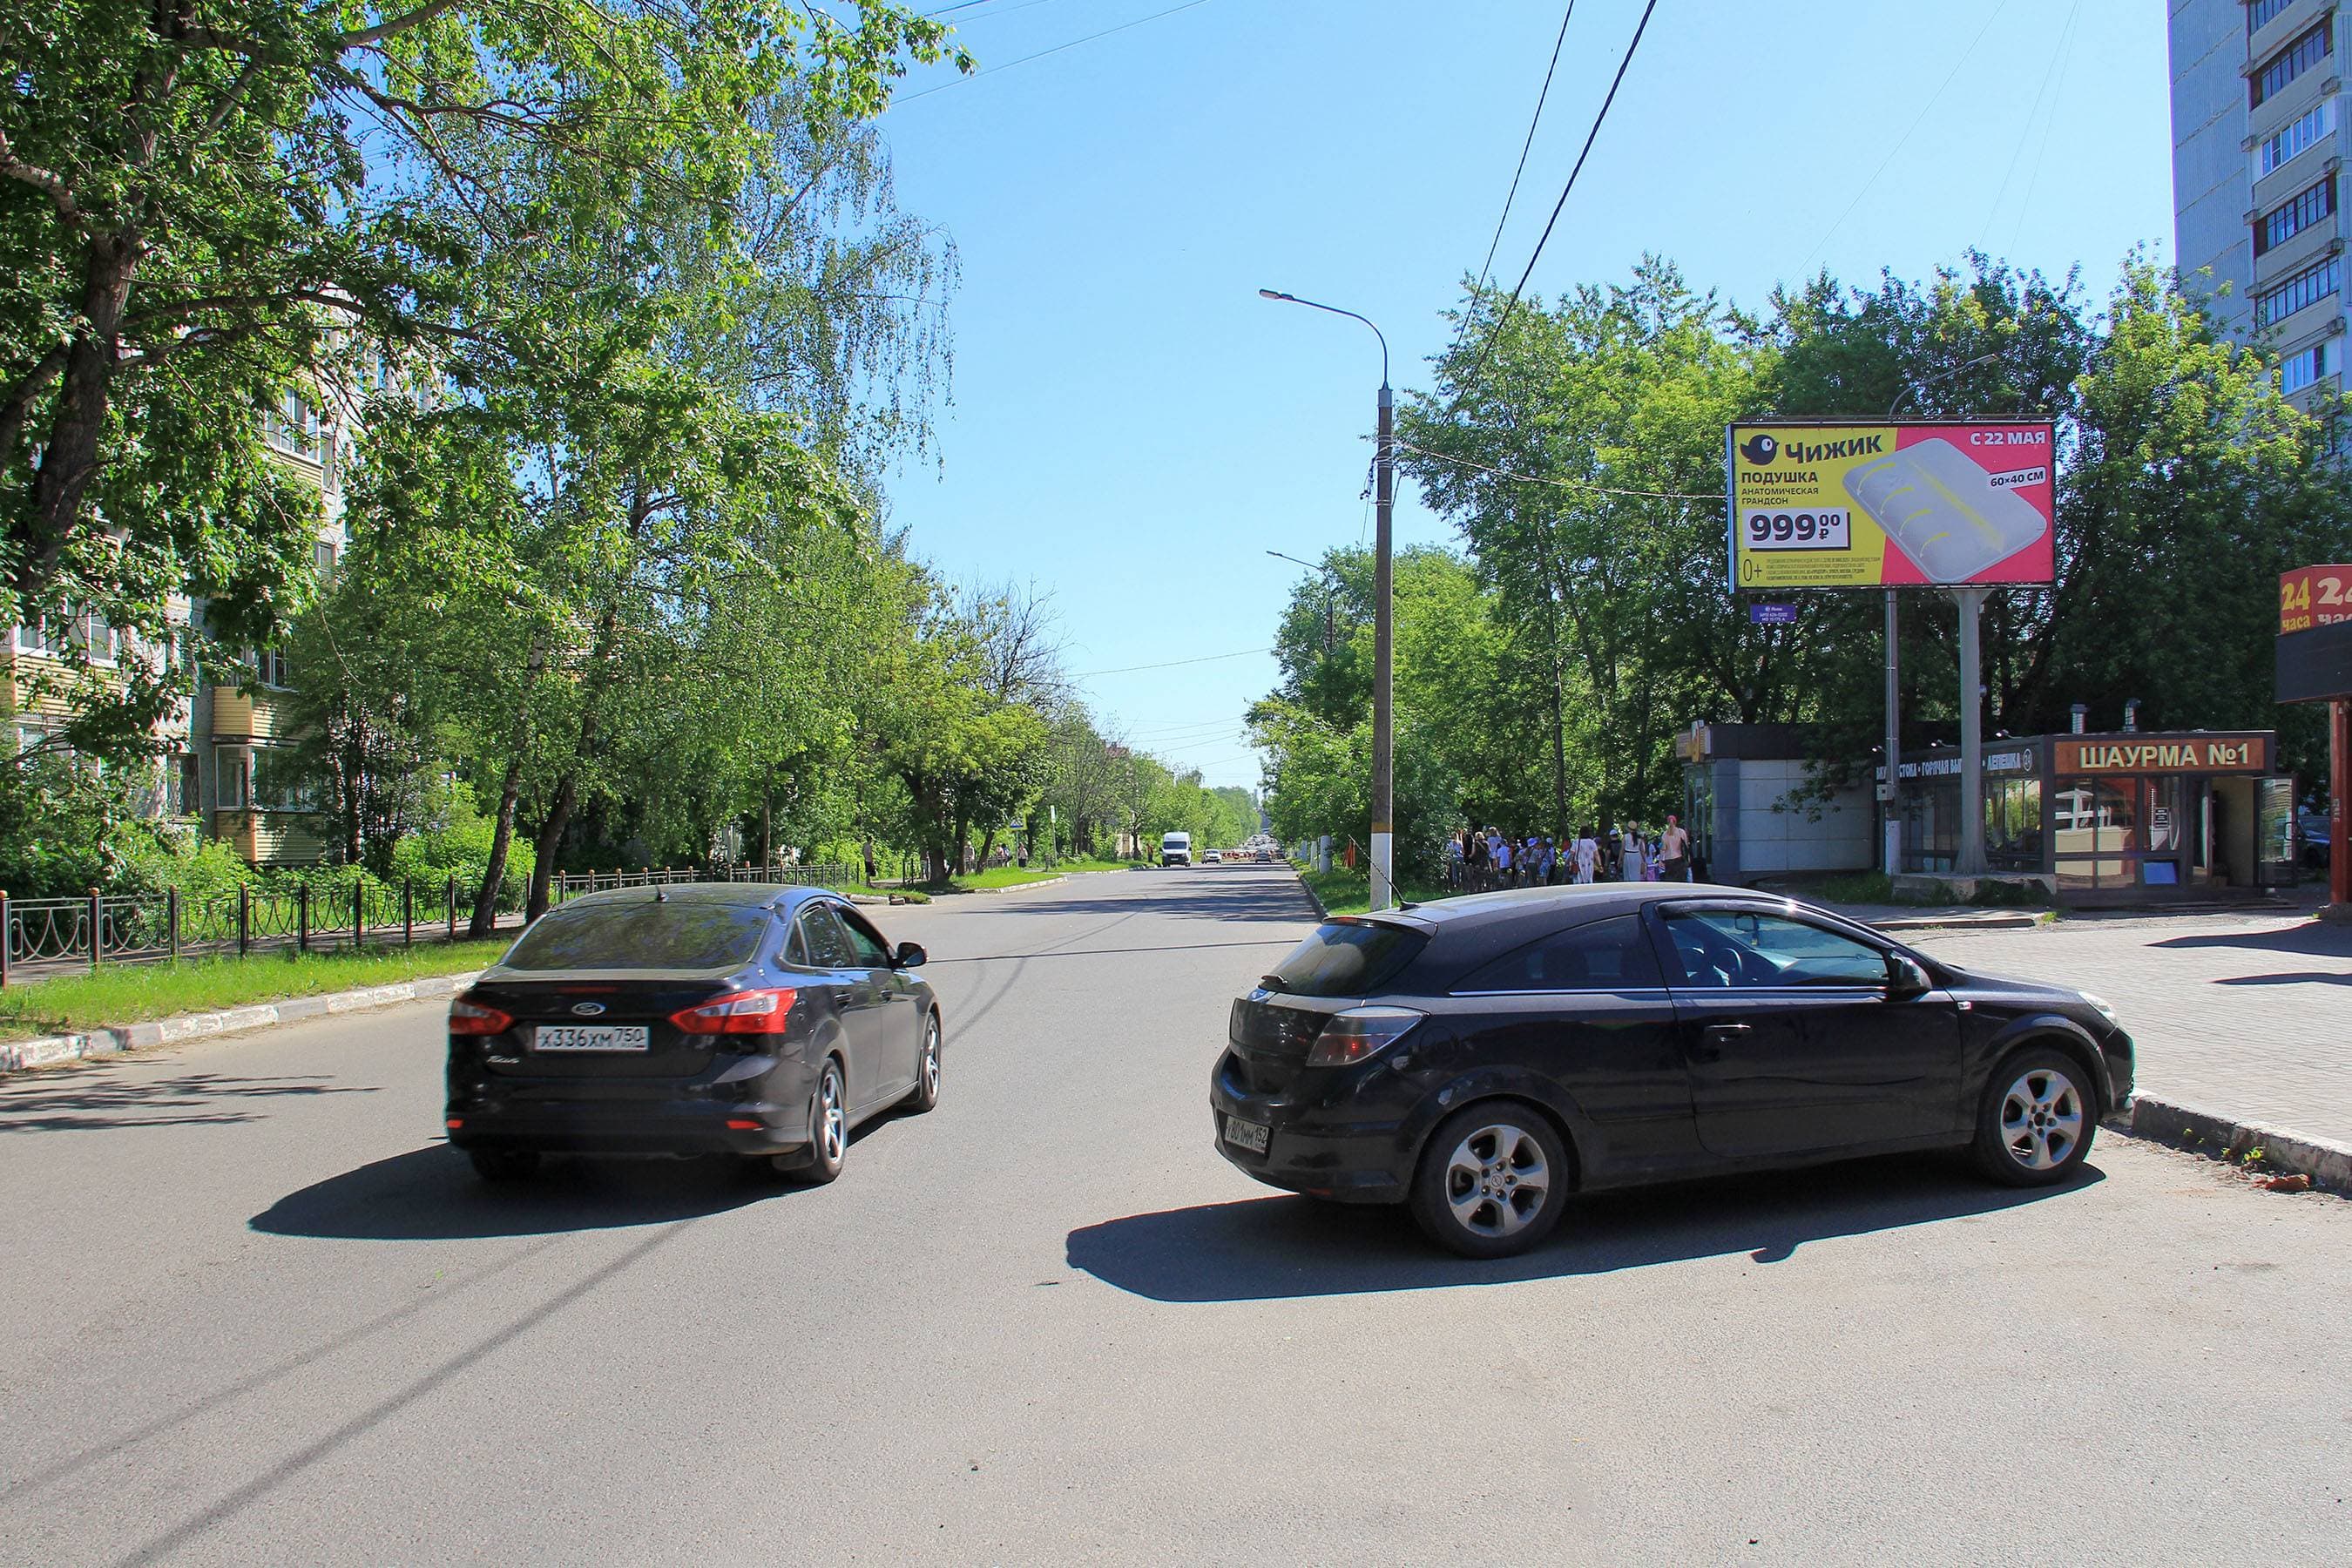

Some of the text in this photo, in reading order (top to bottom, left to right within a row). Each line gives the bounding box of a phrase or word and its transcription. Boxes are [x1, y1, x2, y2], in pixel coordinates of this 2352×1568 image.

[1970, 431, 2045, 445] С 22 МАЯ
[1741, 471, 1819, 485] ПОДУШКА
[2026, 470, 2044, 482] СМ
[1741, 487, 1819, 496] АНАТОМИЧЕСКАЯ
[1749, 514, 1816, 542] 999
[1743, 558, 1762, 582] 0+
[2281, 577, 2311, 611] 24
[2282, 615, 2311, 632] часа
[1987, 753, 2021, 771] ЛЕПЕШКА
[2080, 743, 2248, 768] ШАУРМА №1
[1922, 759, 1950, 777] ГОРЯЧАЯ
[614, 1028, 643, 1042] 750
